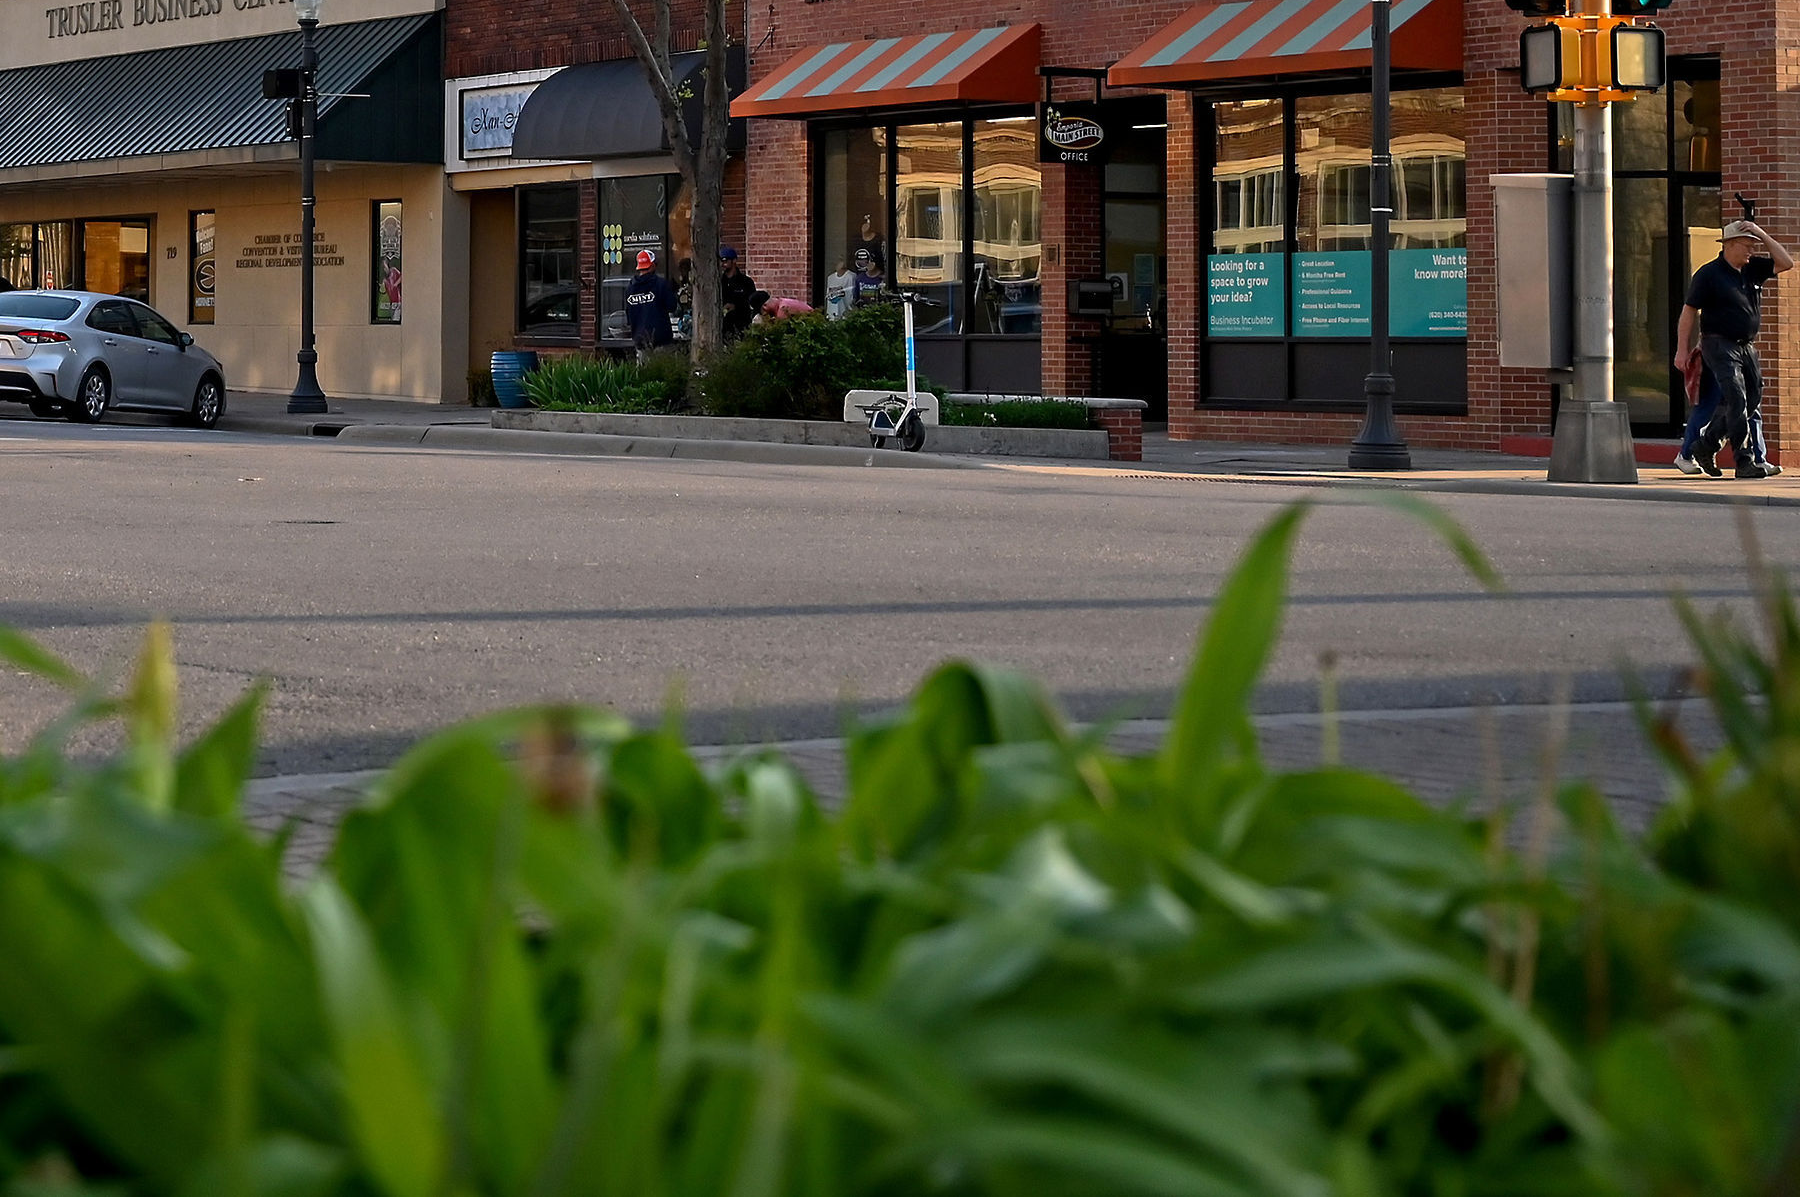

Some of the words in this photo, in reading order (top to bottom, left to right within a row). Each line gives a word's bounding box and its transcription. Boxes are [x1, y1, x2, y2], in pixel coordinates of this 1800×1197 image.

[1056, 121, 1083, 132] Emporia
[1054, 131, 1073, 142] MAIN
[1074, 128, 1099, 139] STREET
[1060, 152, 1088, 161] OFFICE
[254, 234, 281, 244] CHAMBER
[283, 233, 291, 243] OF
[166, 246, 177, 260] 719
[242, 246, 278, 257] CONVENTION
[236, 259, 263, 269] REGIONAL
[313, 256, 345, 267] SSOCIATION
[1210, 259, 1243, 273] Looking
[1245, 259, 1257, 270] for
[1259, 261, 1265, 270] a
[1432, 254, 1457, 266] Want
[1458, 255, 1467, 265] to
[1414, 268, 1439, 279] know
[1210, 278, 1235, 289] space
[1236, 276, 1246, 286] to
[1247, 278, 1269, 289] grow
[1210, 293, 1230, 305] your
[1231, 291, 1253, 302] idea?
[1210, 315, 1240, 325] Business
[1241, 315, 1274, 325] Incubator
